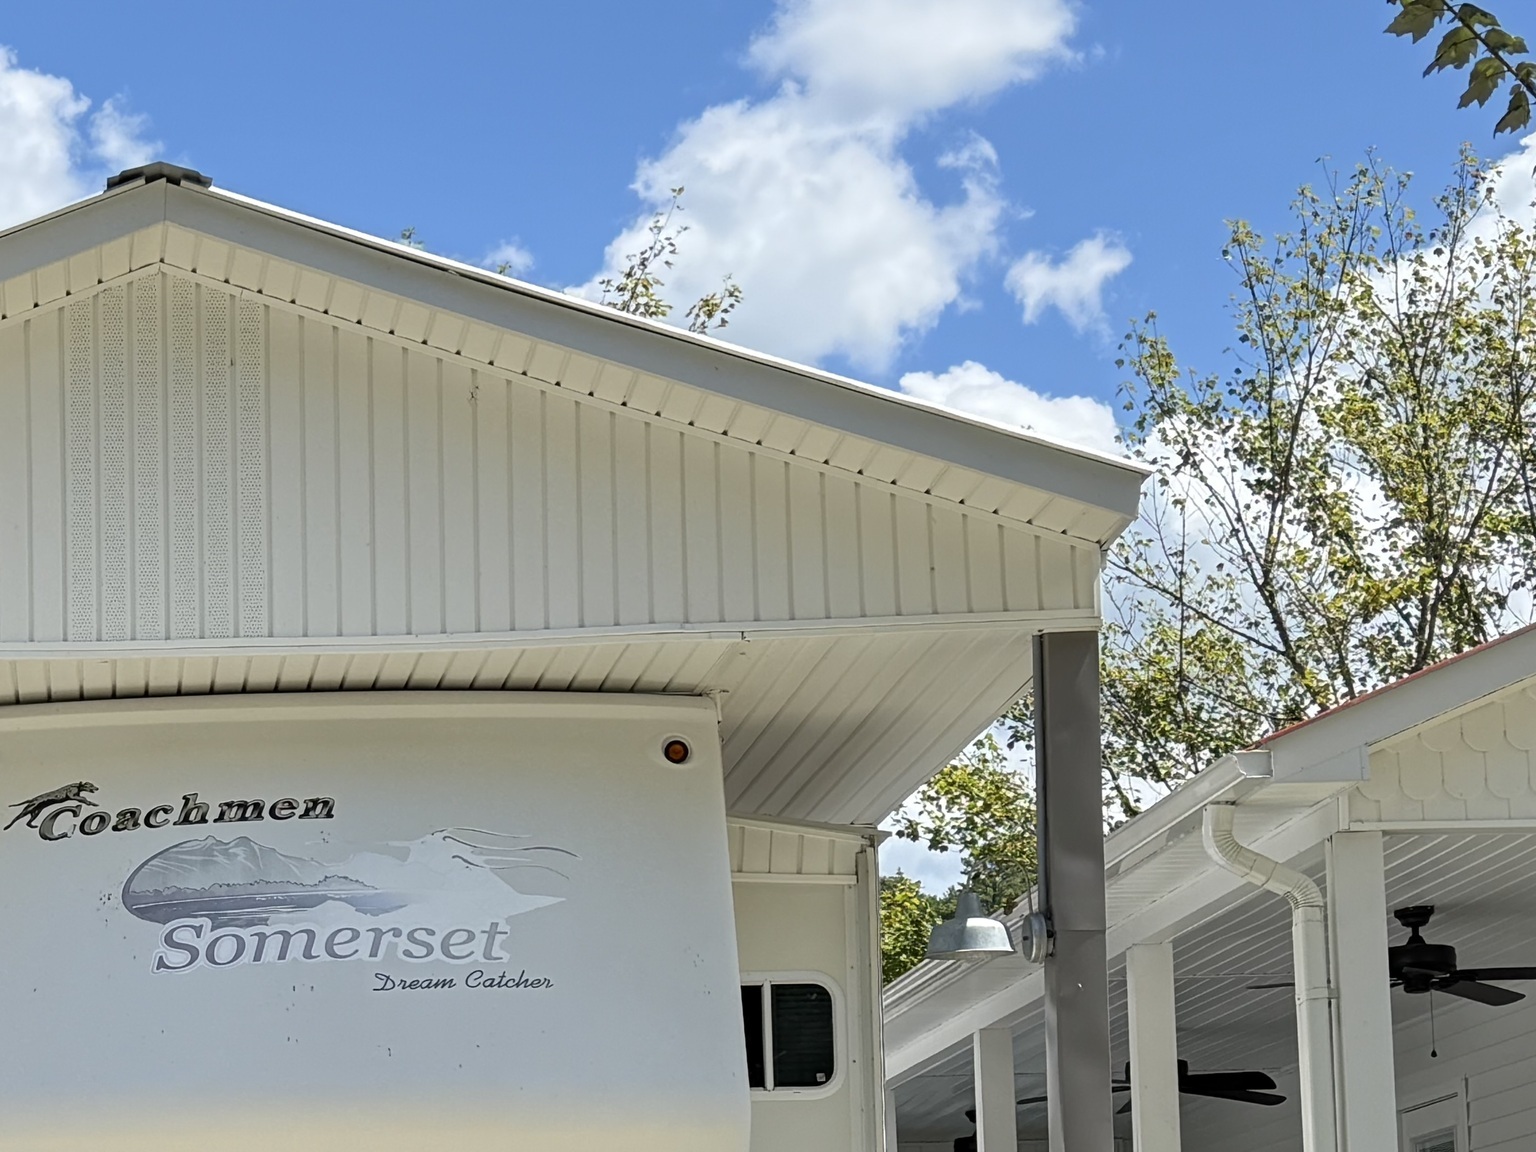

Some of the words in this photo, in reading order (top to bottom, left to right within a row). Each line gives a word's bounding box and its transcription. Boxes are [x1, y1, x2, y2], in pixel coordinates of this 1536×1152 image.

[39, 790, 336, 842] Coachmen
[154, 919, 509, 973] Somerset
[372, 972, 456, 992] Dream
[464, 969, 554, 991] Catcher
